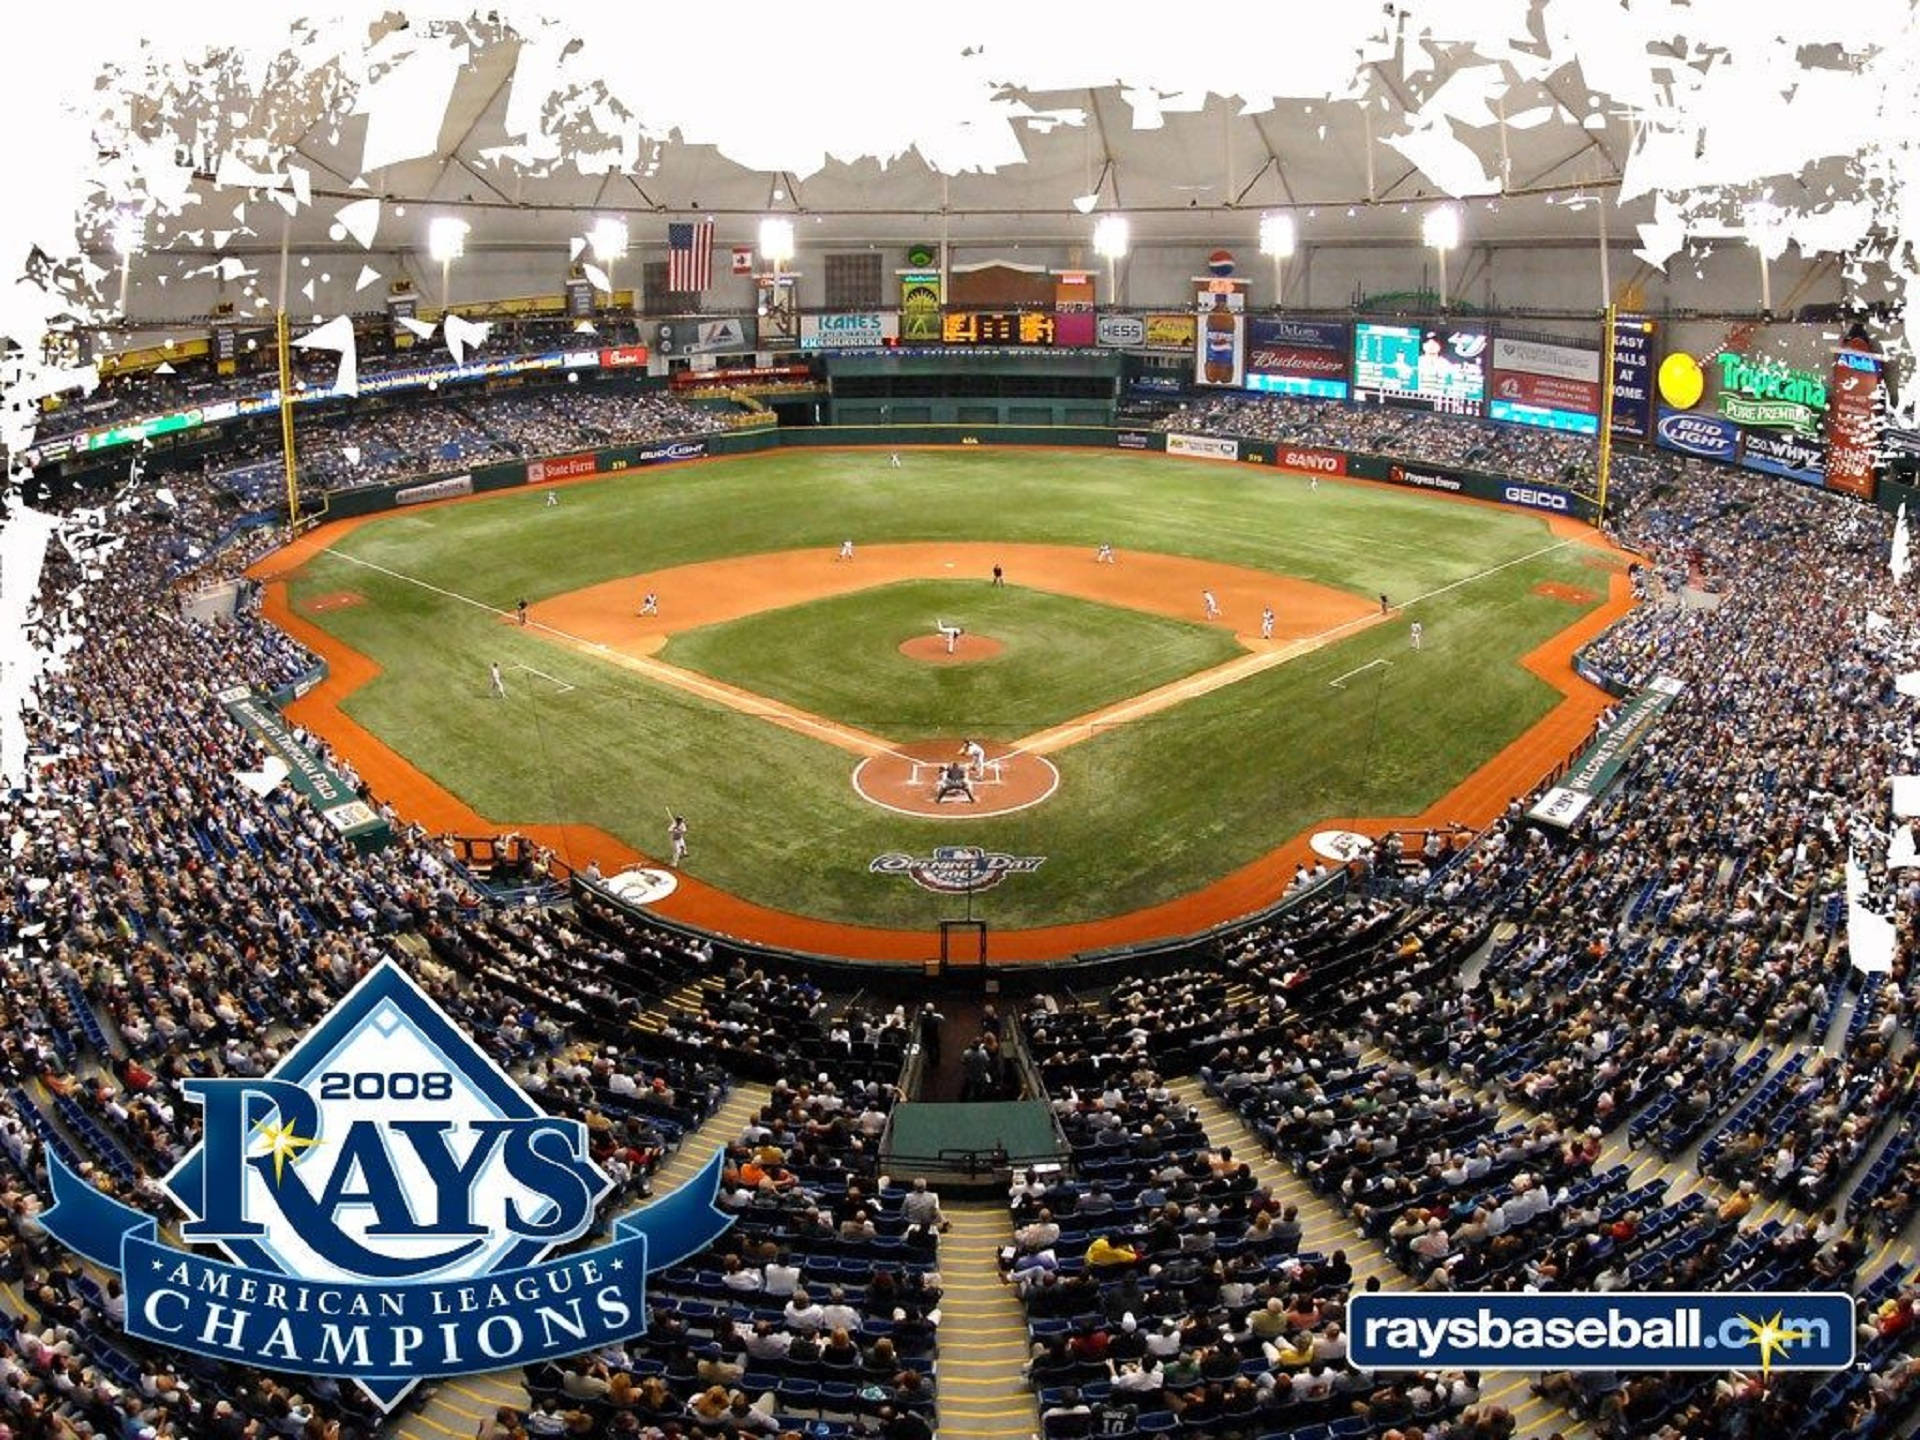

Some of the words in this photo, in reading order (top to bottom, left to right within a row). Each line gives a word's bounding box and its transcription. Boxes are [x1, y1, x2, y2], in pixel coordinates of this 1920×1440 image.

[1102, 325, 1140, 337] HESS
[1251, 350, 1344, 371] Budweiser
[1619, 369, 1635, 382] AT
[1718, 352, 1826, 407] Tropicana
[1612, 385, 1646, 400] OME.
[1727, 402, 1756, 420] PURE
[1758, 405, 1812, 423] PREMIUM
[1677, 419, 1723, 436] BUD
[1670, 429, 1730, 449] LIGHT
[640, 450, 669, 460] BUD
[670, 443, 705, 455] LIGHT
[545, 464, 569, 477] State
[570, 459, 595, 474] Farm
[1285, 453, 1337, 471] SANYO
[1404, 472, 1435, 486] Progress
[1435, 475, 1461, 490] Energy
[1505, 487, 1567, 509] GEICO
